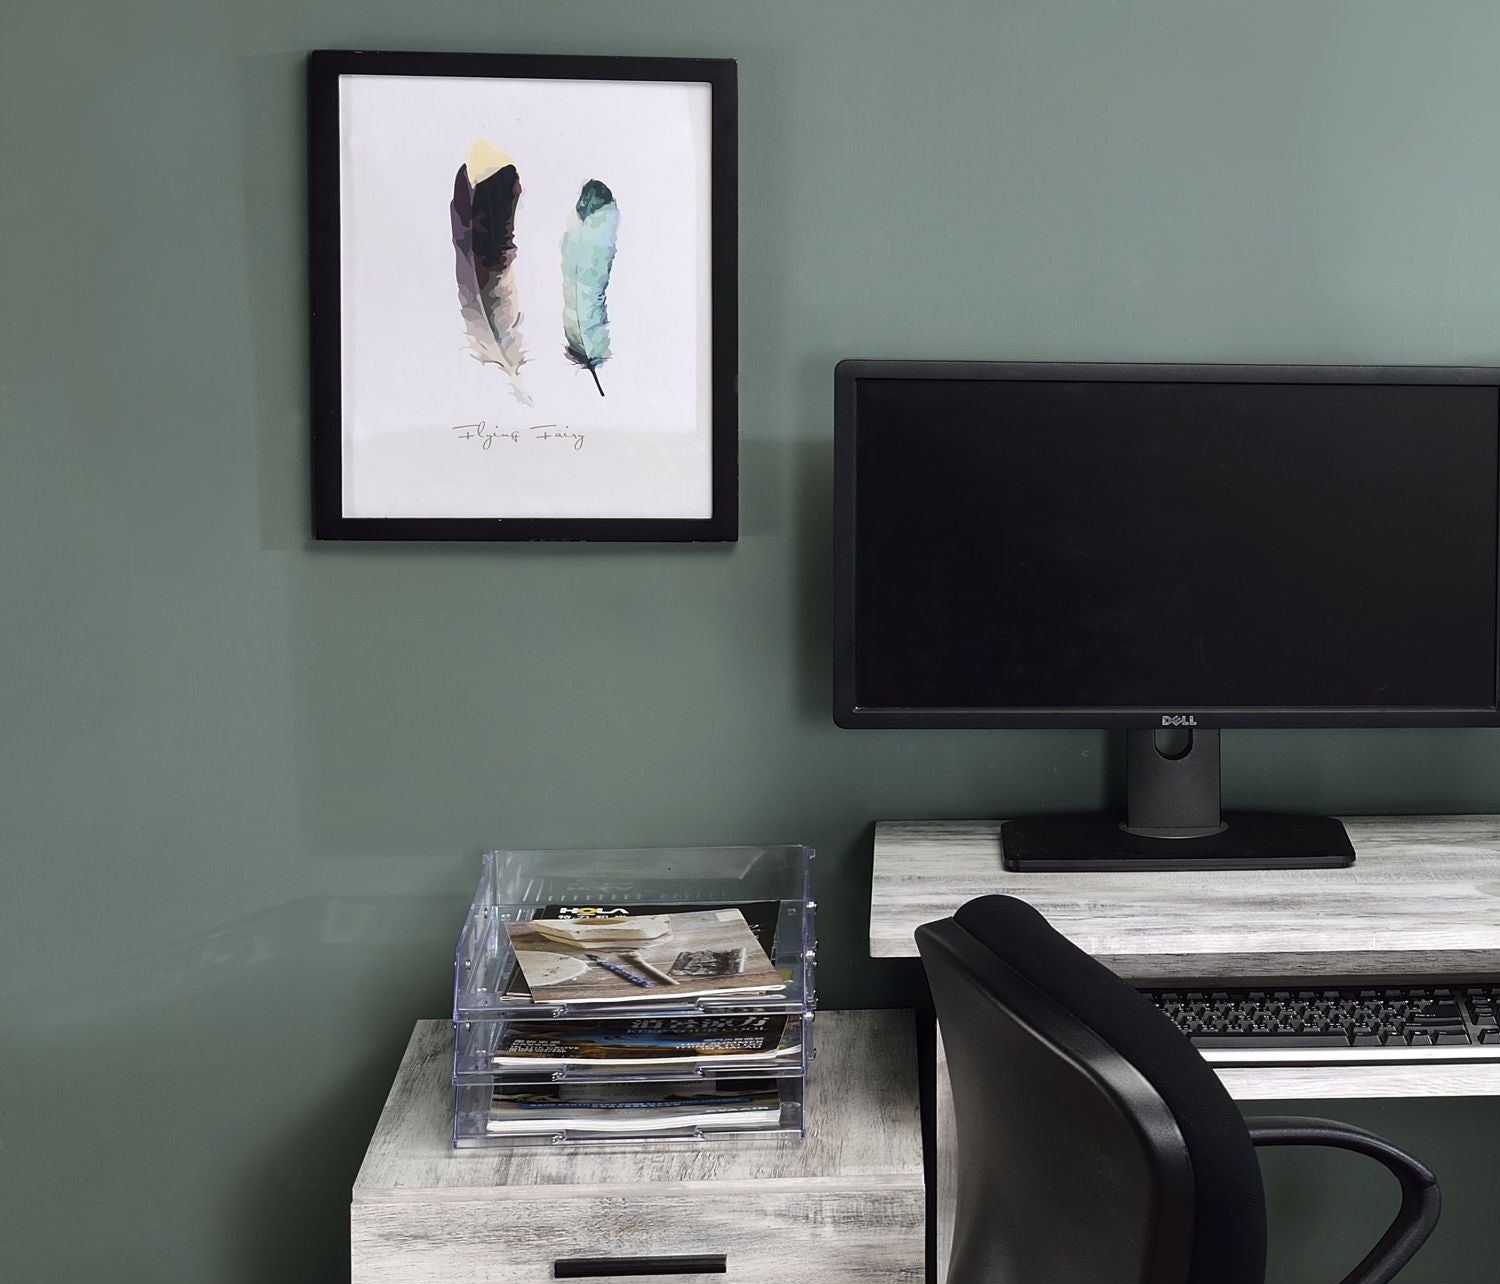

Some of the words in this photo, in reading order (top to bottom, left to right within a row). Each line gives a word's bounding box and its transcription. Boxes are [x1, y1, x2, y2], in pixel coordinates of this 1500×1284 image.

[452, 420, 521, 451] Flying
[529, 424, 585, 451] Fairy
[1162, 715, 1197, 726] DELL
[560, 907, 629, 916] HOLA
